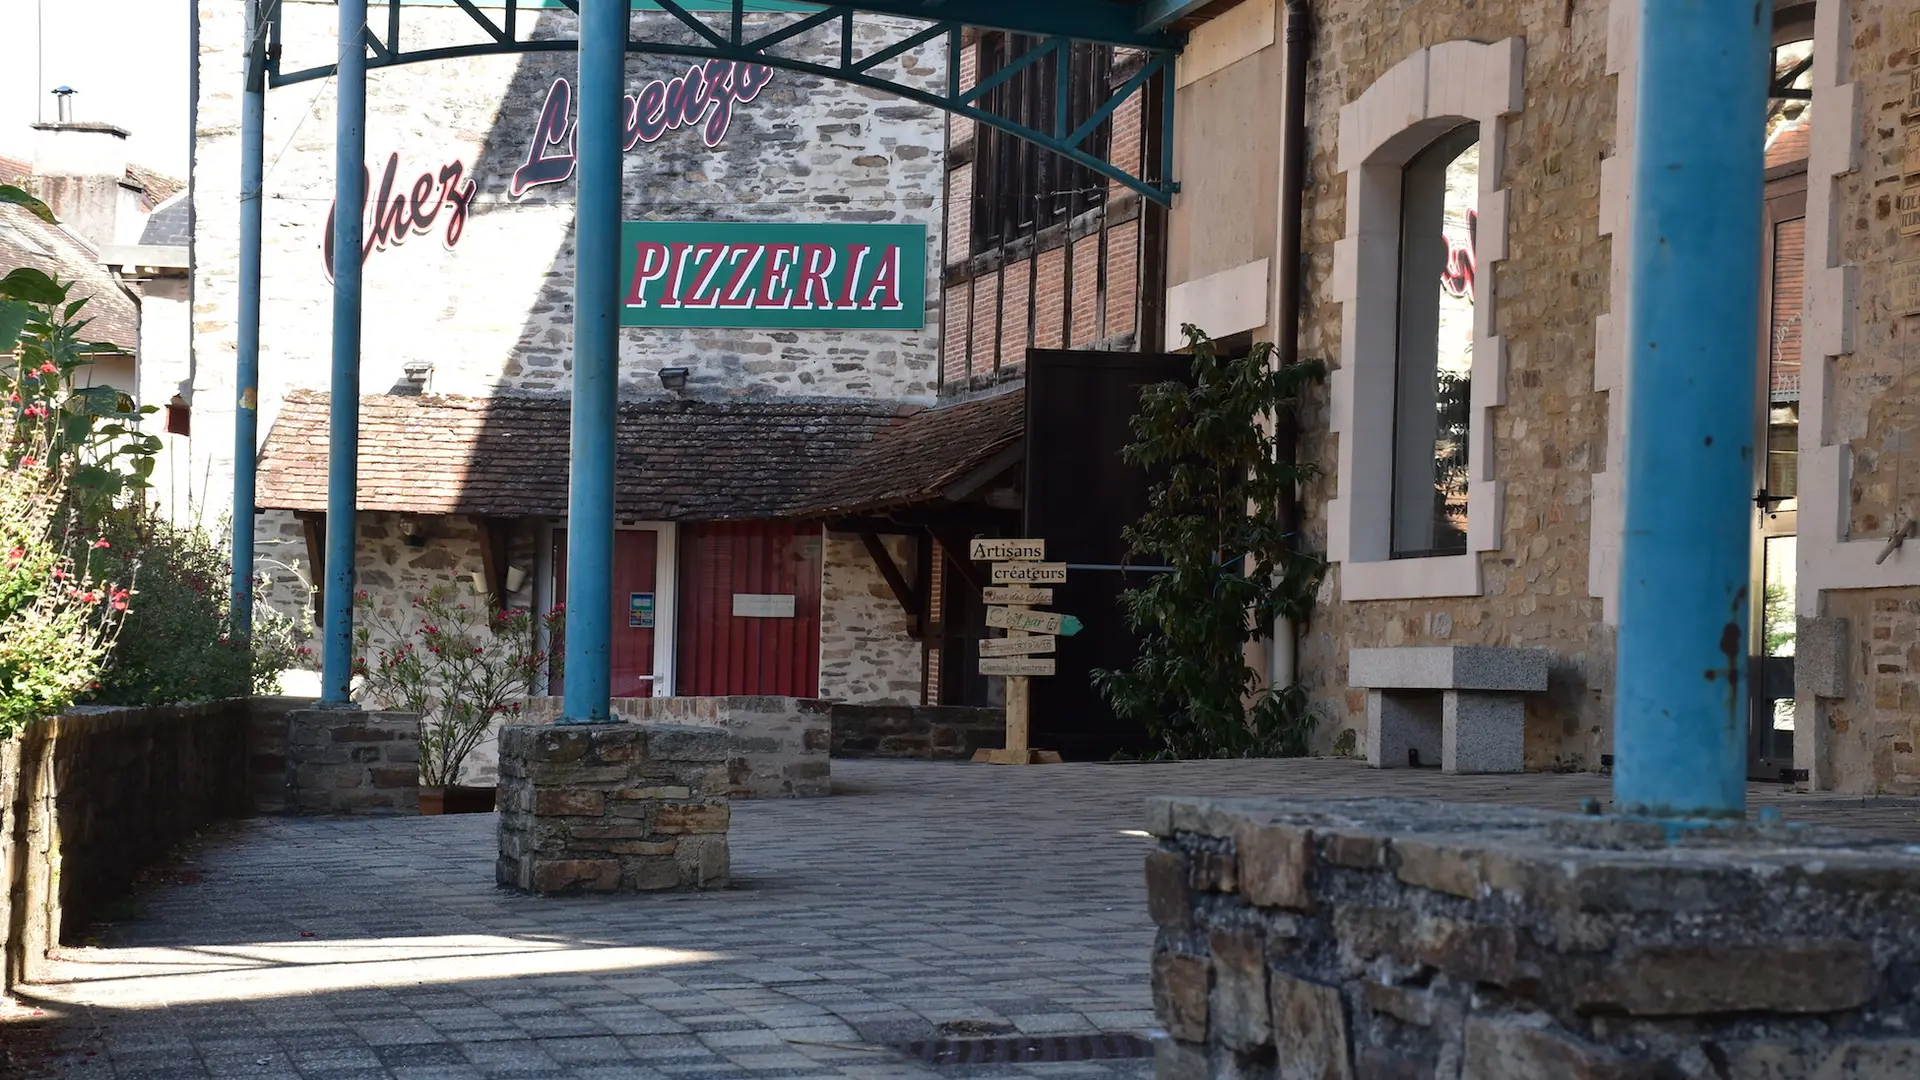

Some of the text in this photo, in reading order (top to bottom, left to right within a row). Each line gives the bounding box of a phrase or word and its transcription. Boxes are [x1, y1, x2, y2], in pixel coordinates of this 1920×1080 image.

[511, 50, 774, 196] Lenzo
[625, 242, 903, 311] PIZZERIA
[973, 542, 1042, 558] Artisans
[994, 565, 1065, 580] créateurs
[1022, 616, 1045, 631] par
